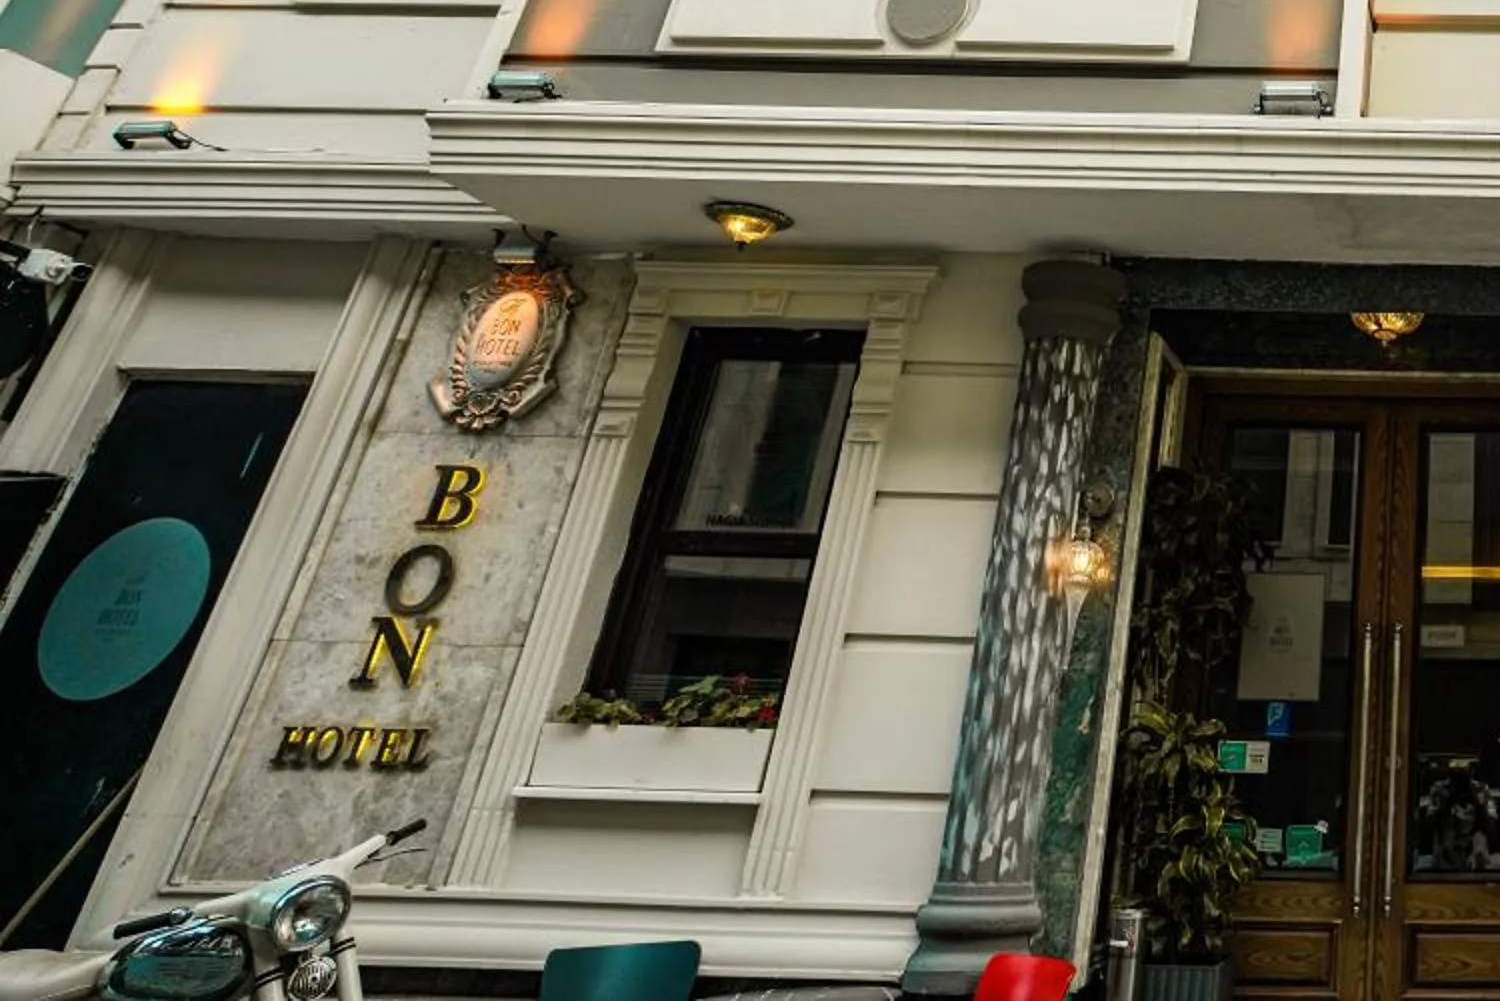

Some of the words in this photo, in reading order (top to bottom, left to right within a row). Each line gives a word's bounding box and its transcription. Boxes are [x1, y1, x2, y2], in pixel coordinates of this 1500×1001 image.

[490, 318, 522, 336] BON
[478, 338, 521, 357] HOTEL
[349, 464, 487, 691] BON
[268, 725, 432, 771] HOTEL
